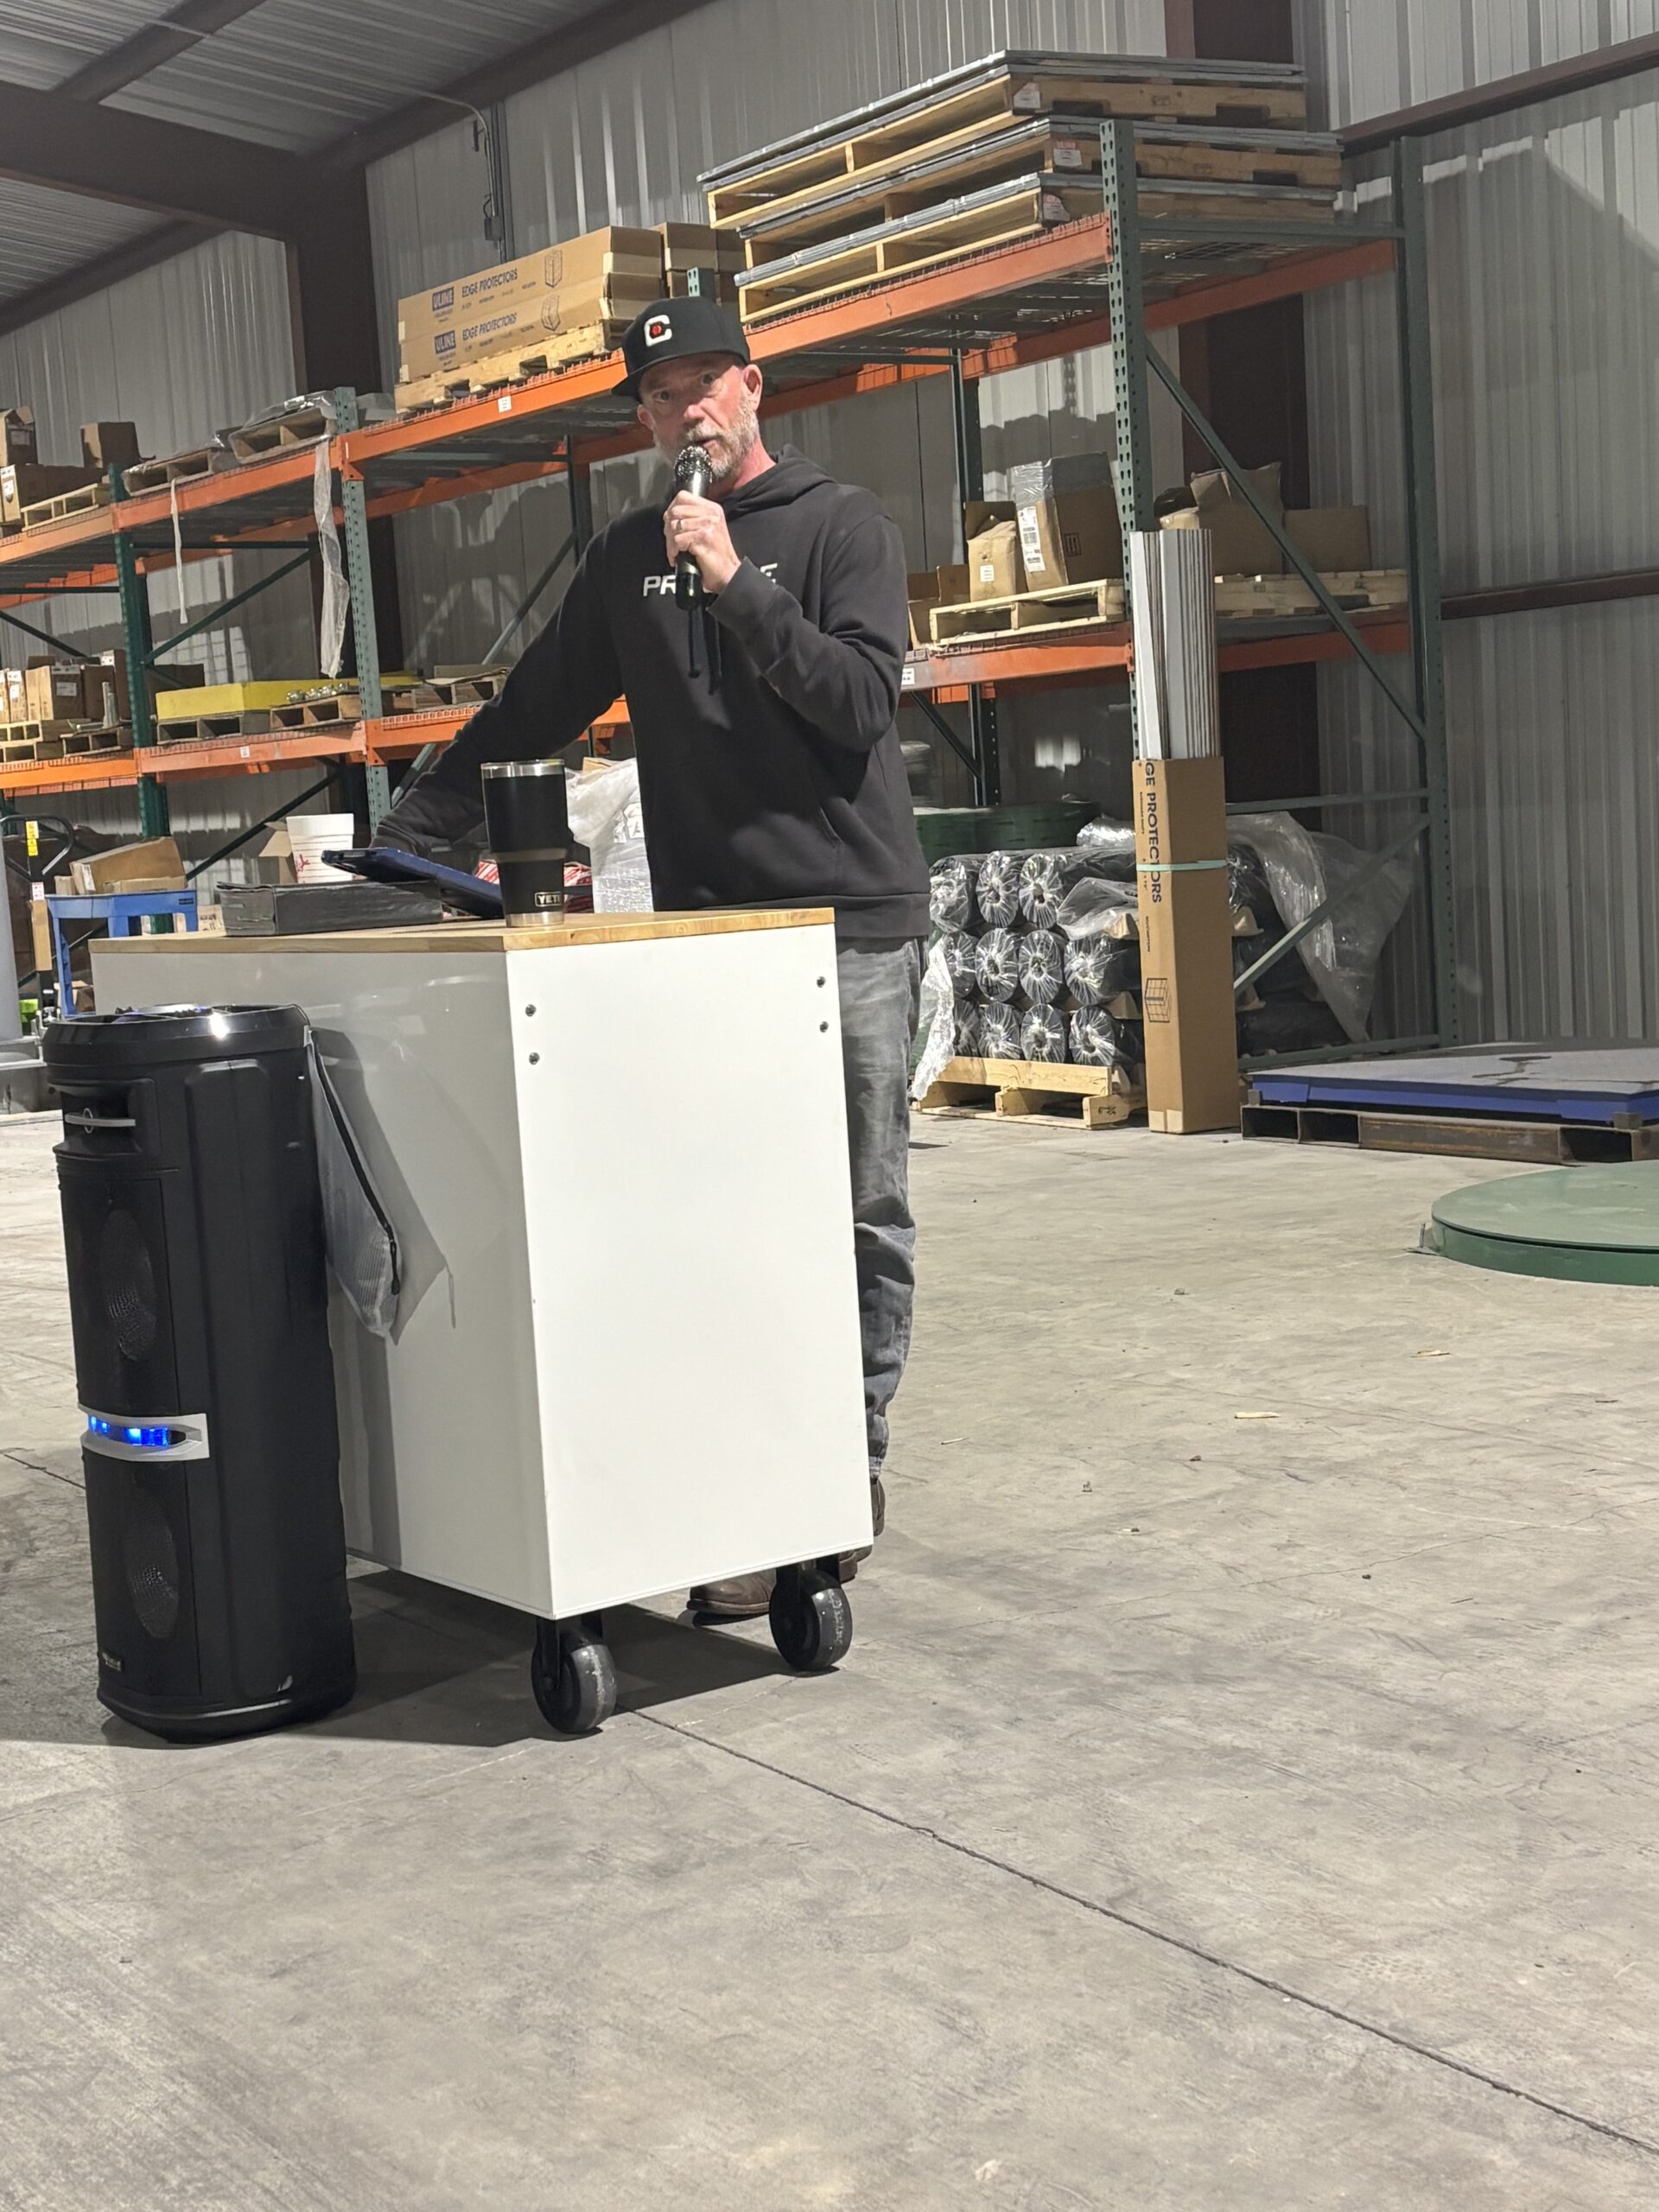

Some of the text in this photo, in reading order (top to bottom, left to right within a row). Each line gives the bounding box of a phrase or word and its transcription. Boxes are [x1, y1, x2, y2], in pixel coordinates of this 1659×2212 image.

[461, 281, 479, 298] EDGE
[479, 269, 518, 291] PROTECTORS
[462, 325, 479, 341] EDGE
[479, 312, 518, 334] PROTECTORS
[537, 894, 560, 904] YETI
